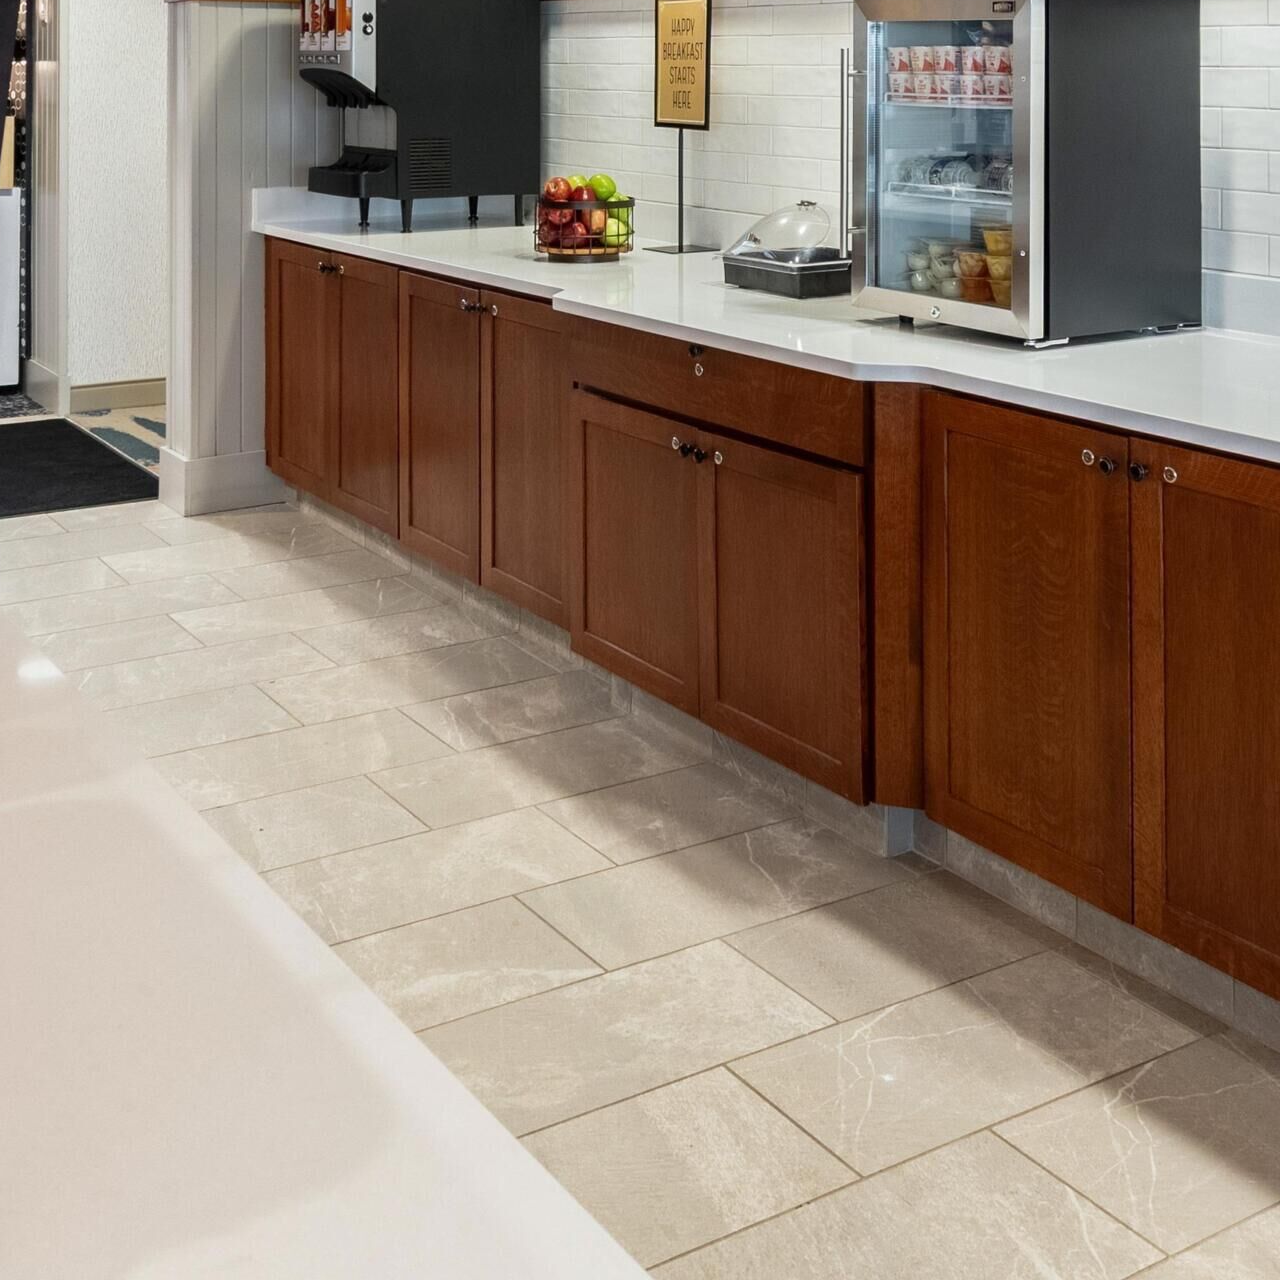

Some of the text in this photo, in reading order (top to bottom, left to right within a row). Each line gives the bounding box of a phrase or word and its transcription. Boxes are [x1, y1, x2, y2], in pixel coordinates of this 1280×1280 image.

[671, 18, 696, 36] HAPPY
[663, 42, 704, 61] BREAKFAST
[669, 66, 696, 85] STARTS
[672, 90, 692, 109] HERE
